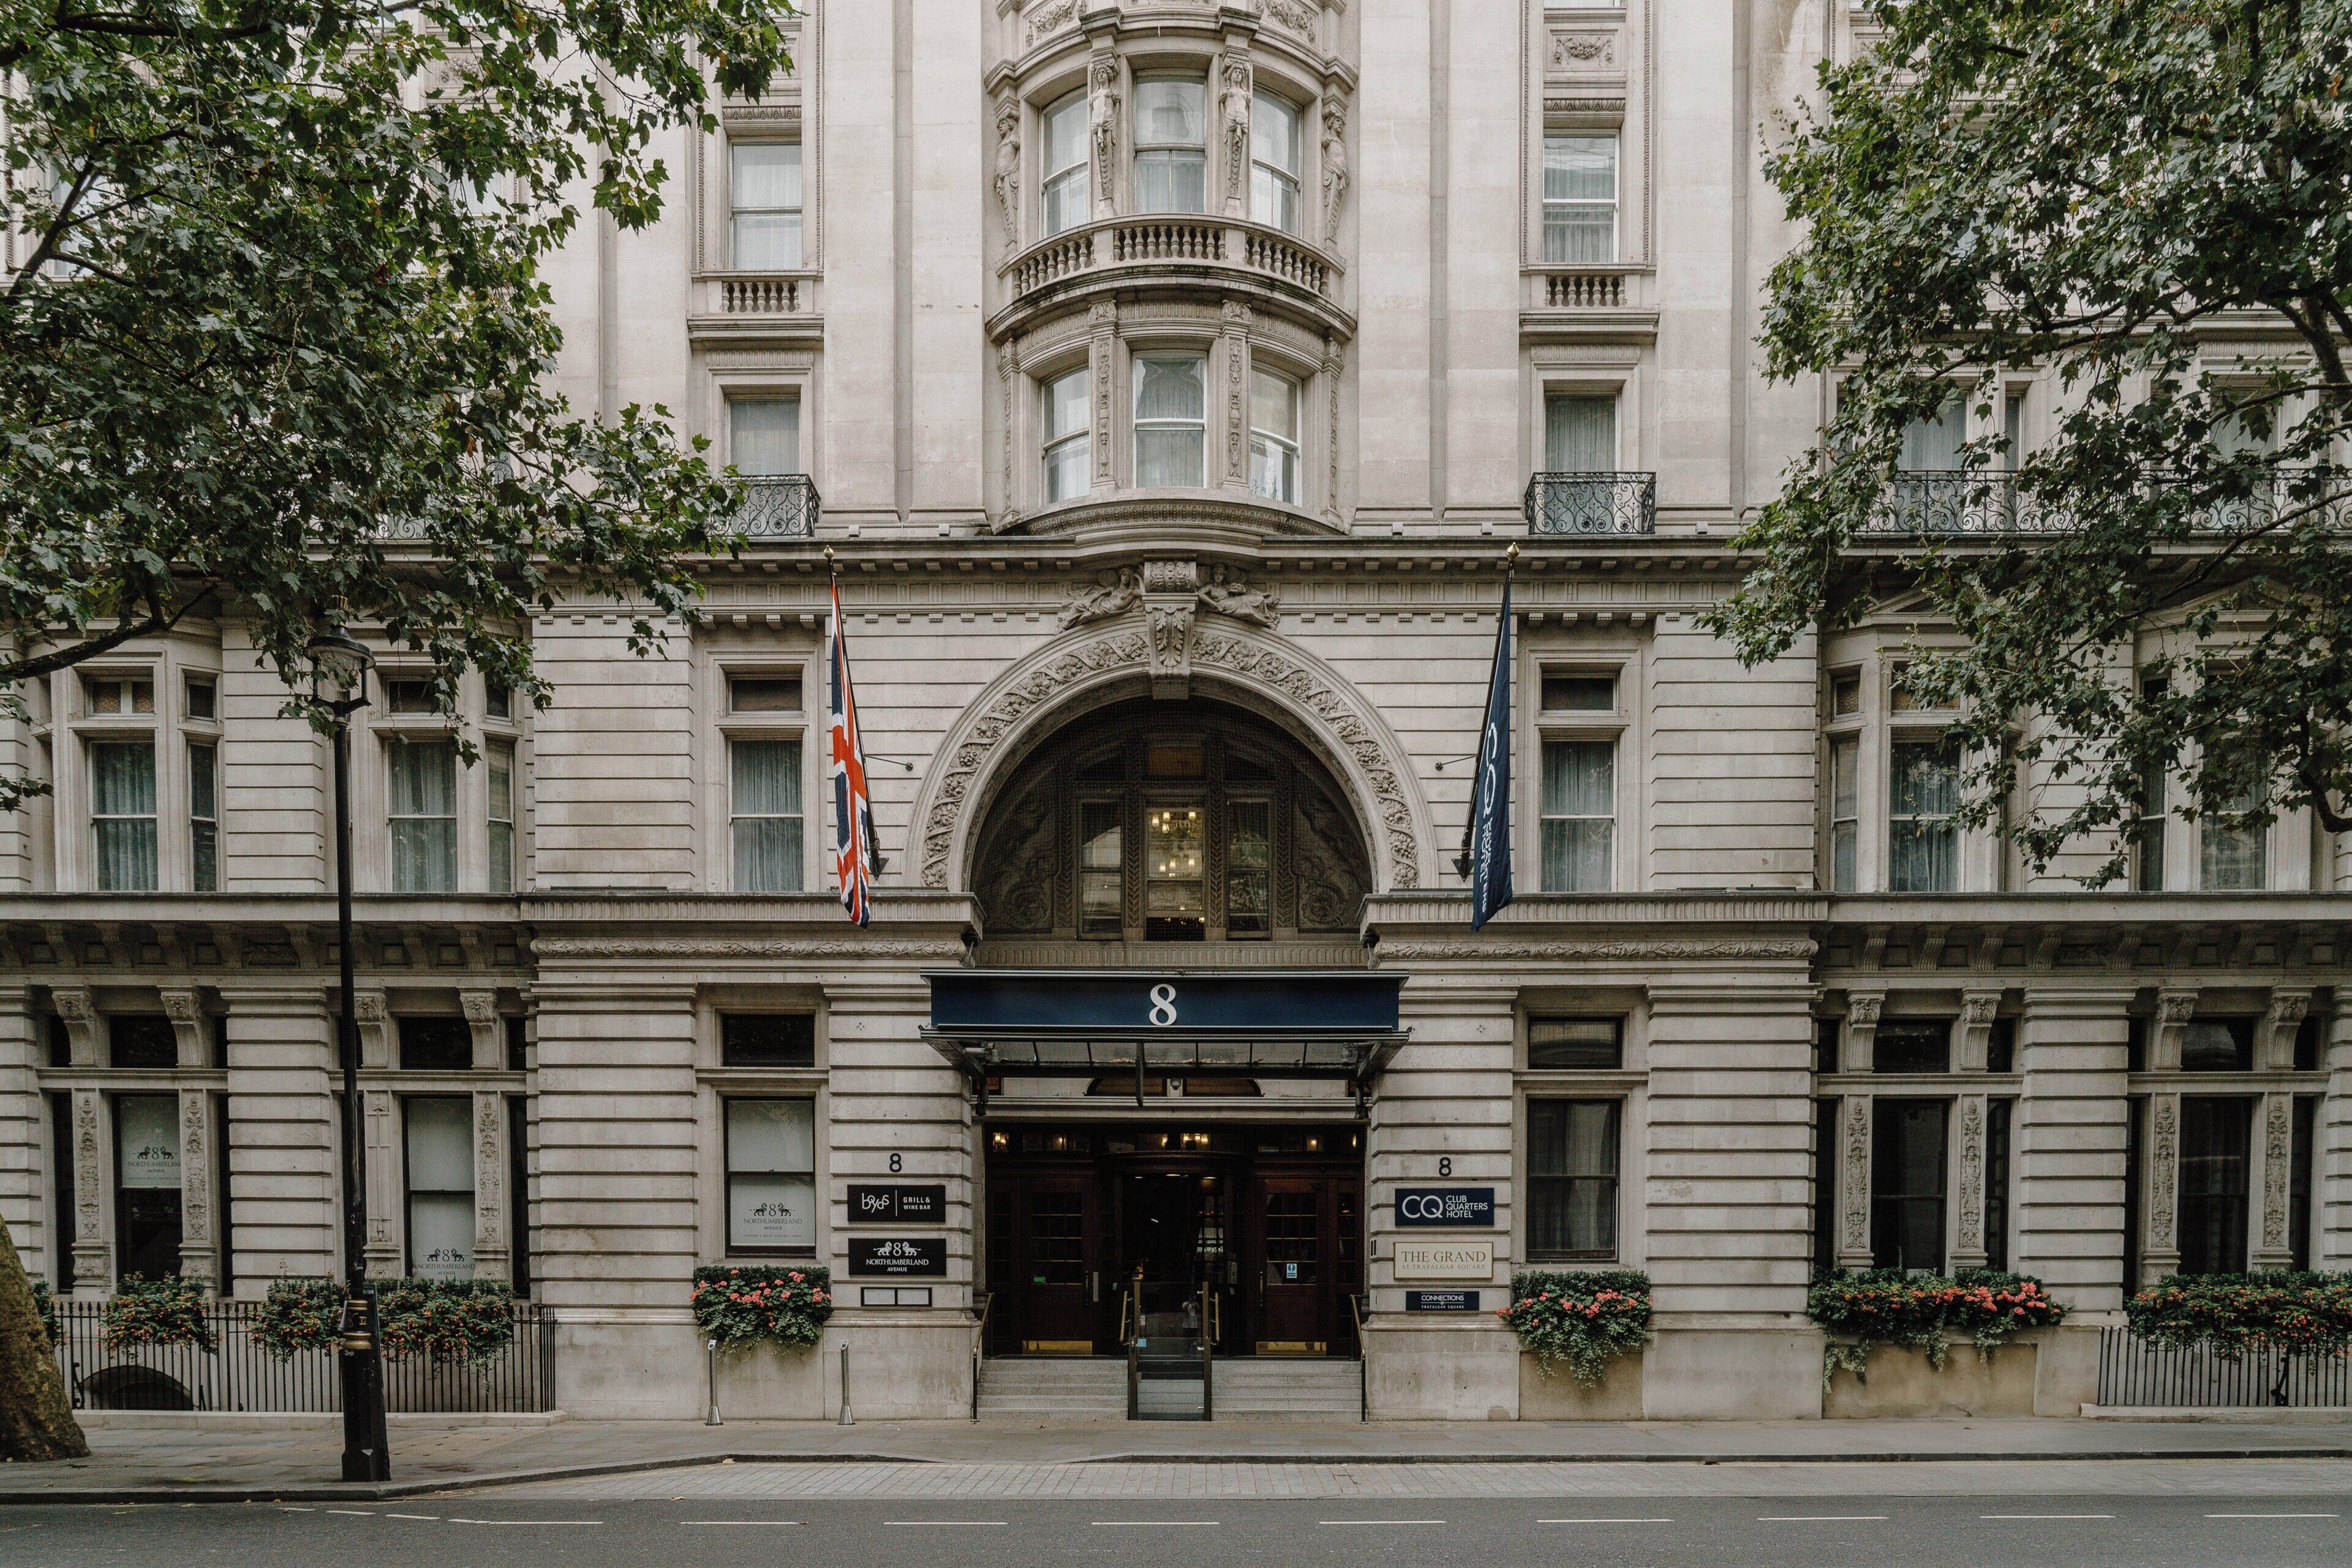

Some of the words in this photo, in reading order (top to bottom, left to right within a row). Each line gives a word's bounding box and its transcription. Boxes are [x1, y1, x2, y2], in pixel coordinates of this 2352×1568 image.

[1149, 984, 1177, 1026] 8
[152, 1147, 159, 1159] 8
[889, 1153, 902, 1173] 8
[1439, 1156, 1452, 1177] 8
[769, 1204, 777, 1216] 8
[862, 1193, 889, 1213] boyds
[1402, 1195, 1443, 1218] CQ
[442, 1249, 450, 1262] 8
[893, 1242, 902, 1256] 8
[1401, 1251, 1430, 1262] THE
[1434, 1251, 1486, 1262] GRAND
